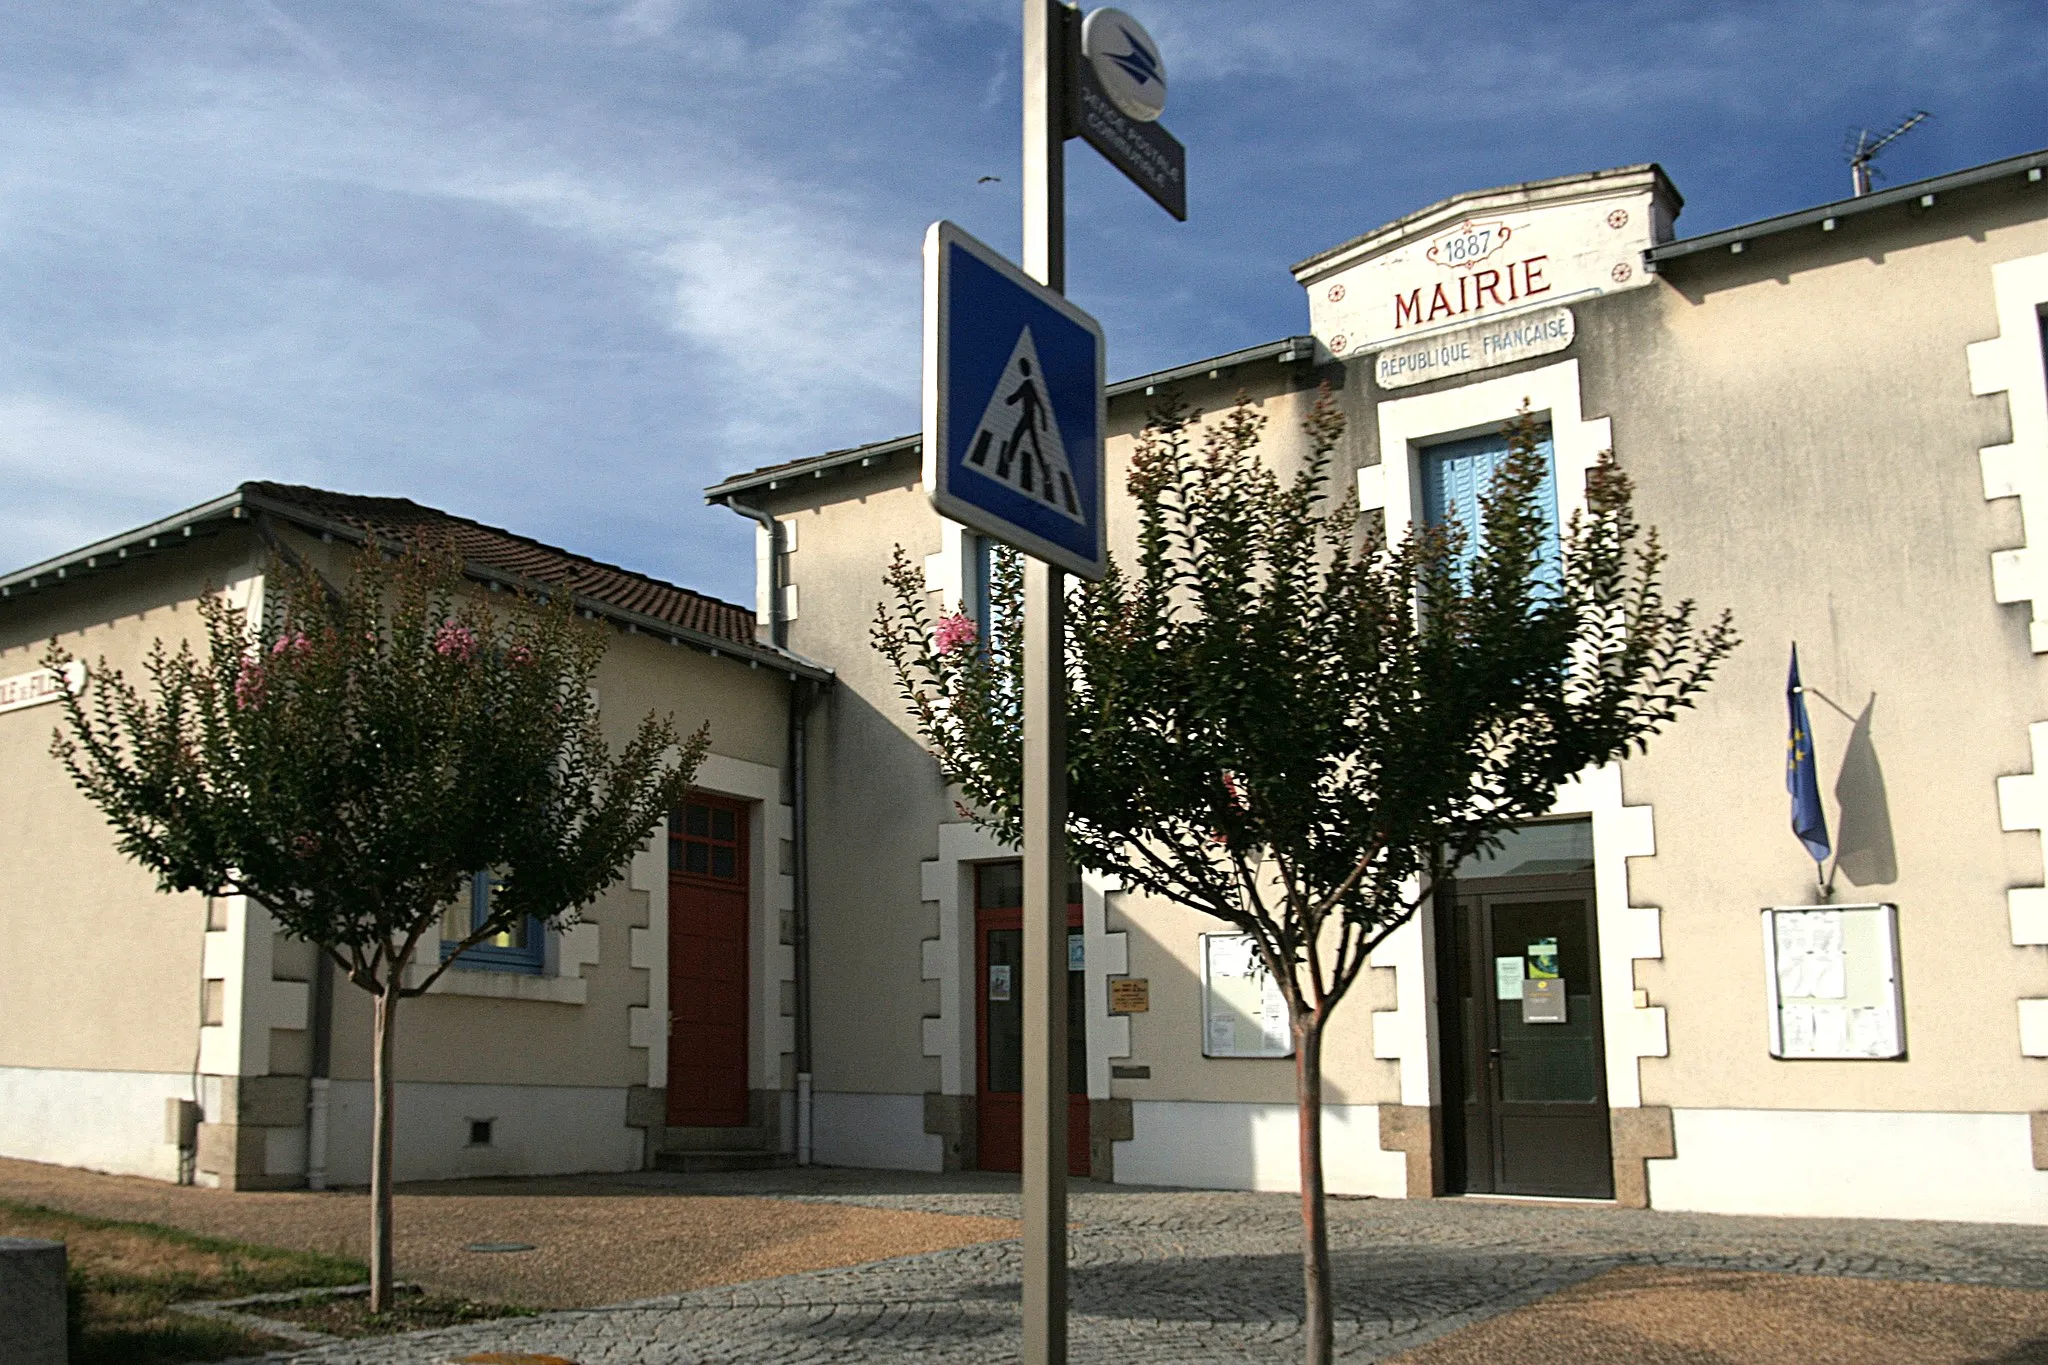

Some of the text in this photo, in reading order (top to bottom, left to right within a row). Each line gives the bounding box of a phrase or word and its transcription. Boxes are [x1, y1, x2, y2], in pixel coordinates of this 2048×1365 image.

[1443, 230, 1491, 262] 1887
[1394, 254, 1552, 330] MAIRIE
[1379, 317, 1569, 378] RÉPUBLIQUE FRANÇAISE
